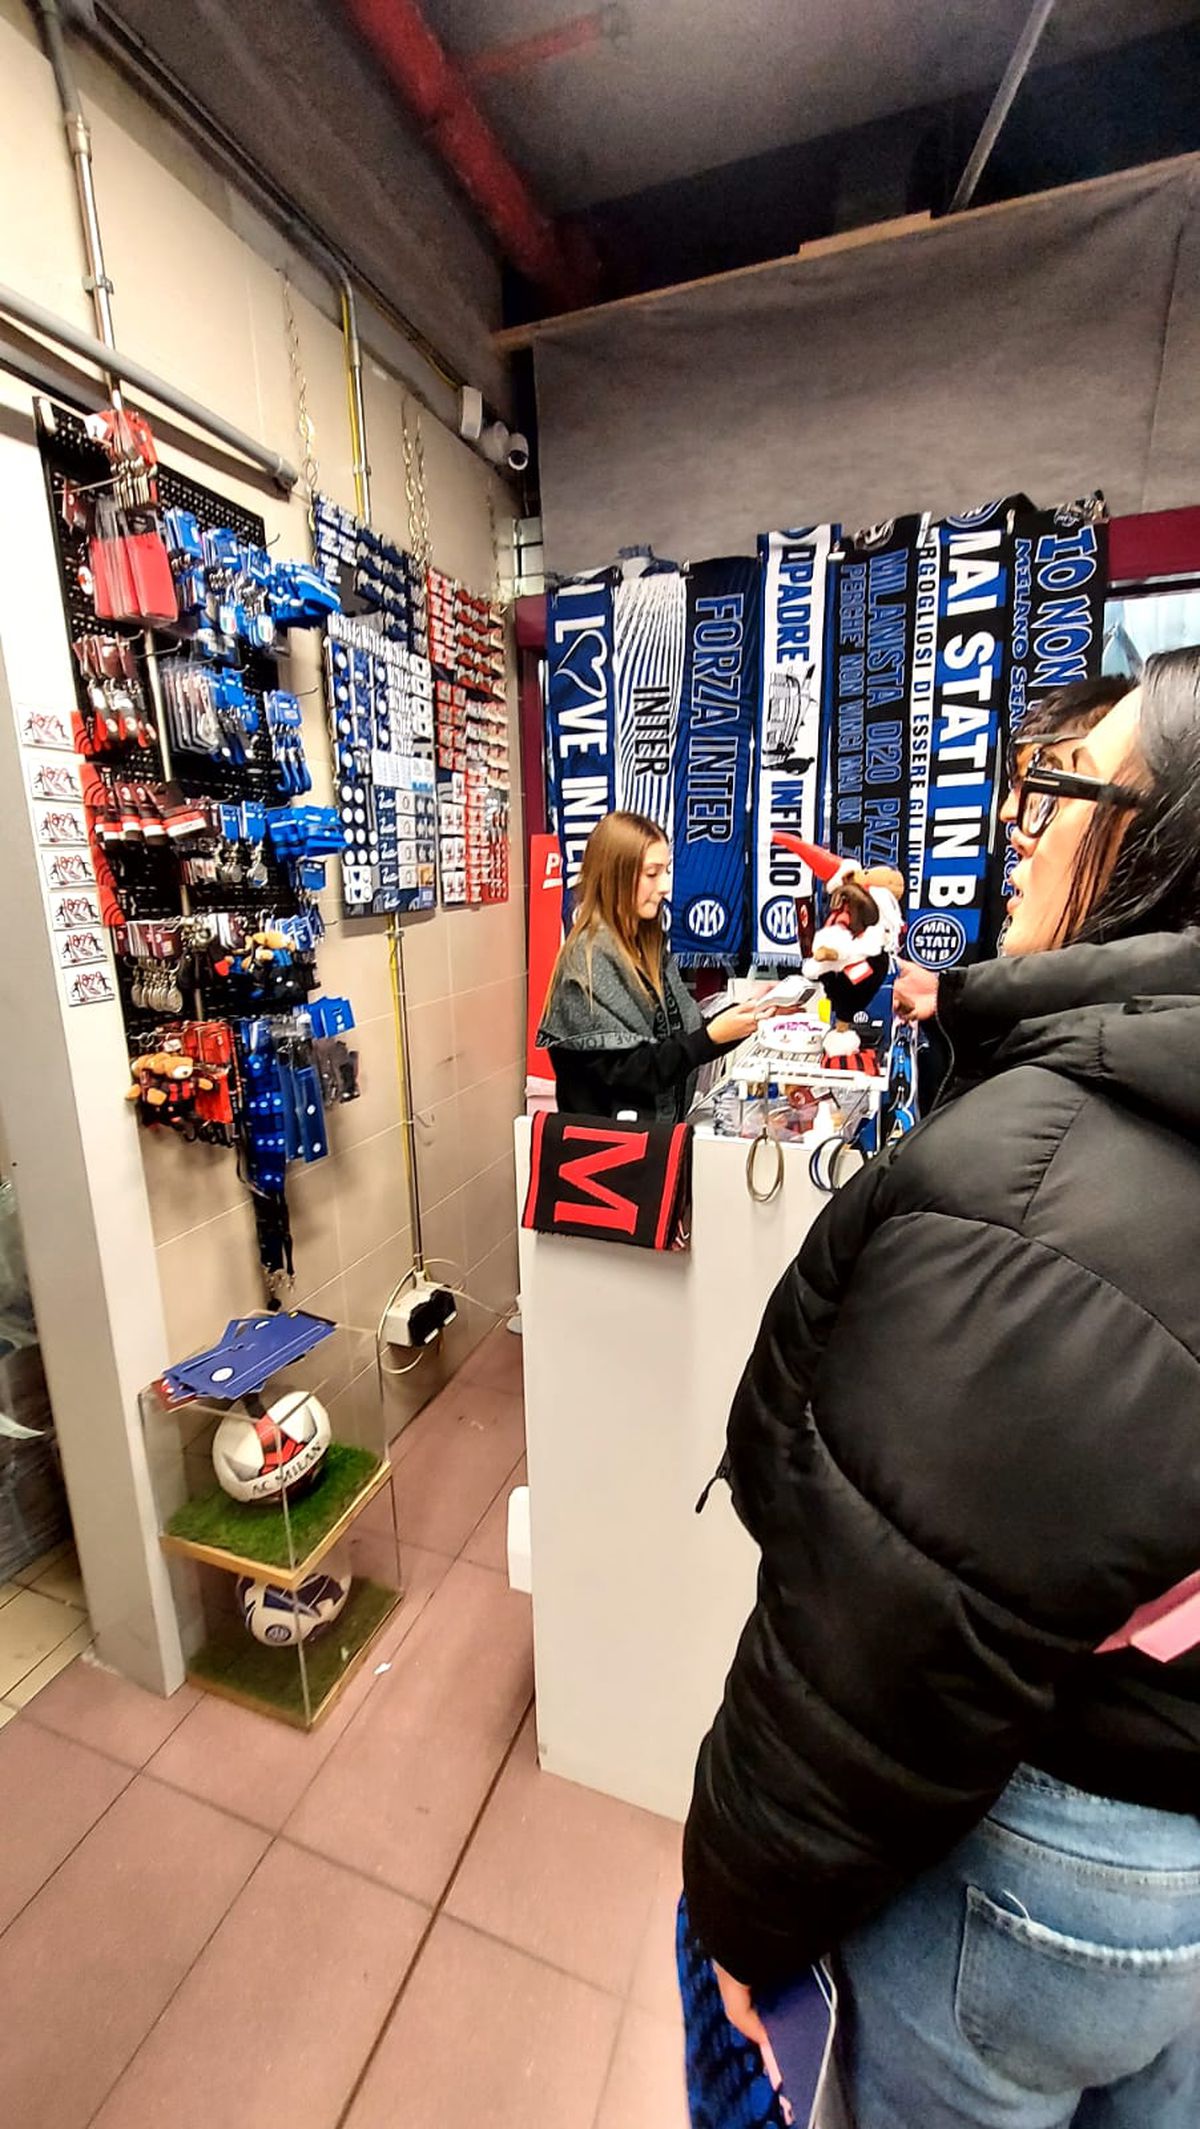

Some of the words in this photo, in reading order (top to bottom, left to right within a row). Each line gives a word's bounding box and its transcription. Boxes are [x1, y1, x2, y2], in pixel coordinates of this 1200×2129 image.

[1035, 524, 1098, 592] IO
[867, 548, 909, 709] MILANISTA
[914, 541, 937, 668] RGOGLIOSI
[1011, 538, 1032, 660] MILANO
[690, 593, 744, 729] FORZA
[1028, 594, 1093, 687] NON
[839, 653, 865, 697] NON
[913, 681, 932, 702] DI
[633, 686, 670, 777] INTER
[838, 699, 864, 753] VINCI
[936, 631, 996, 788] STATI
[838, 755, 863, 794] MAI
[910, 714, 929, 789] ESSERE
[686, 735, 739, 844] INTER
[837, 797, 863, 824] UN
[932, 806, 983, 859] IN
[928, 875, 977, 908] B
[915, 935, 957, 948] STATI
[922, 921, 951, 934] MAI
[275, 1442, 321, 1482] MILAN
